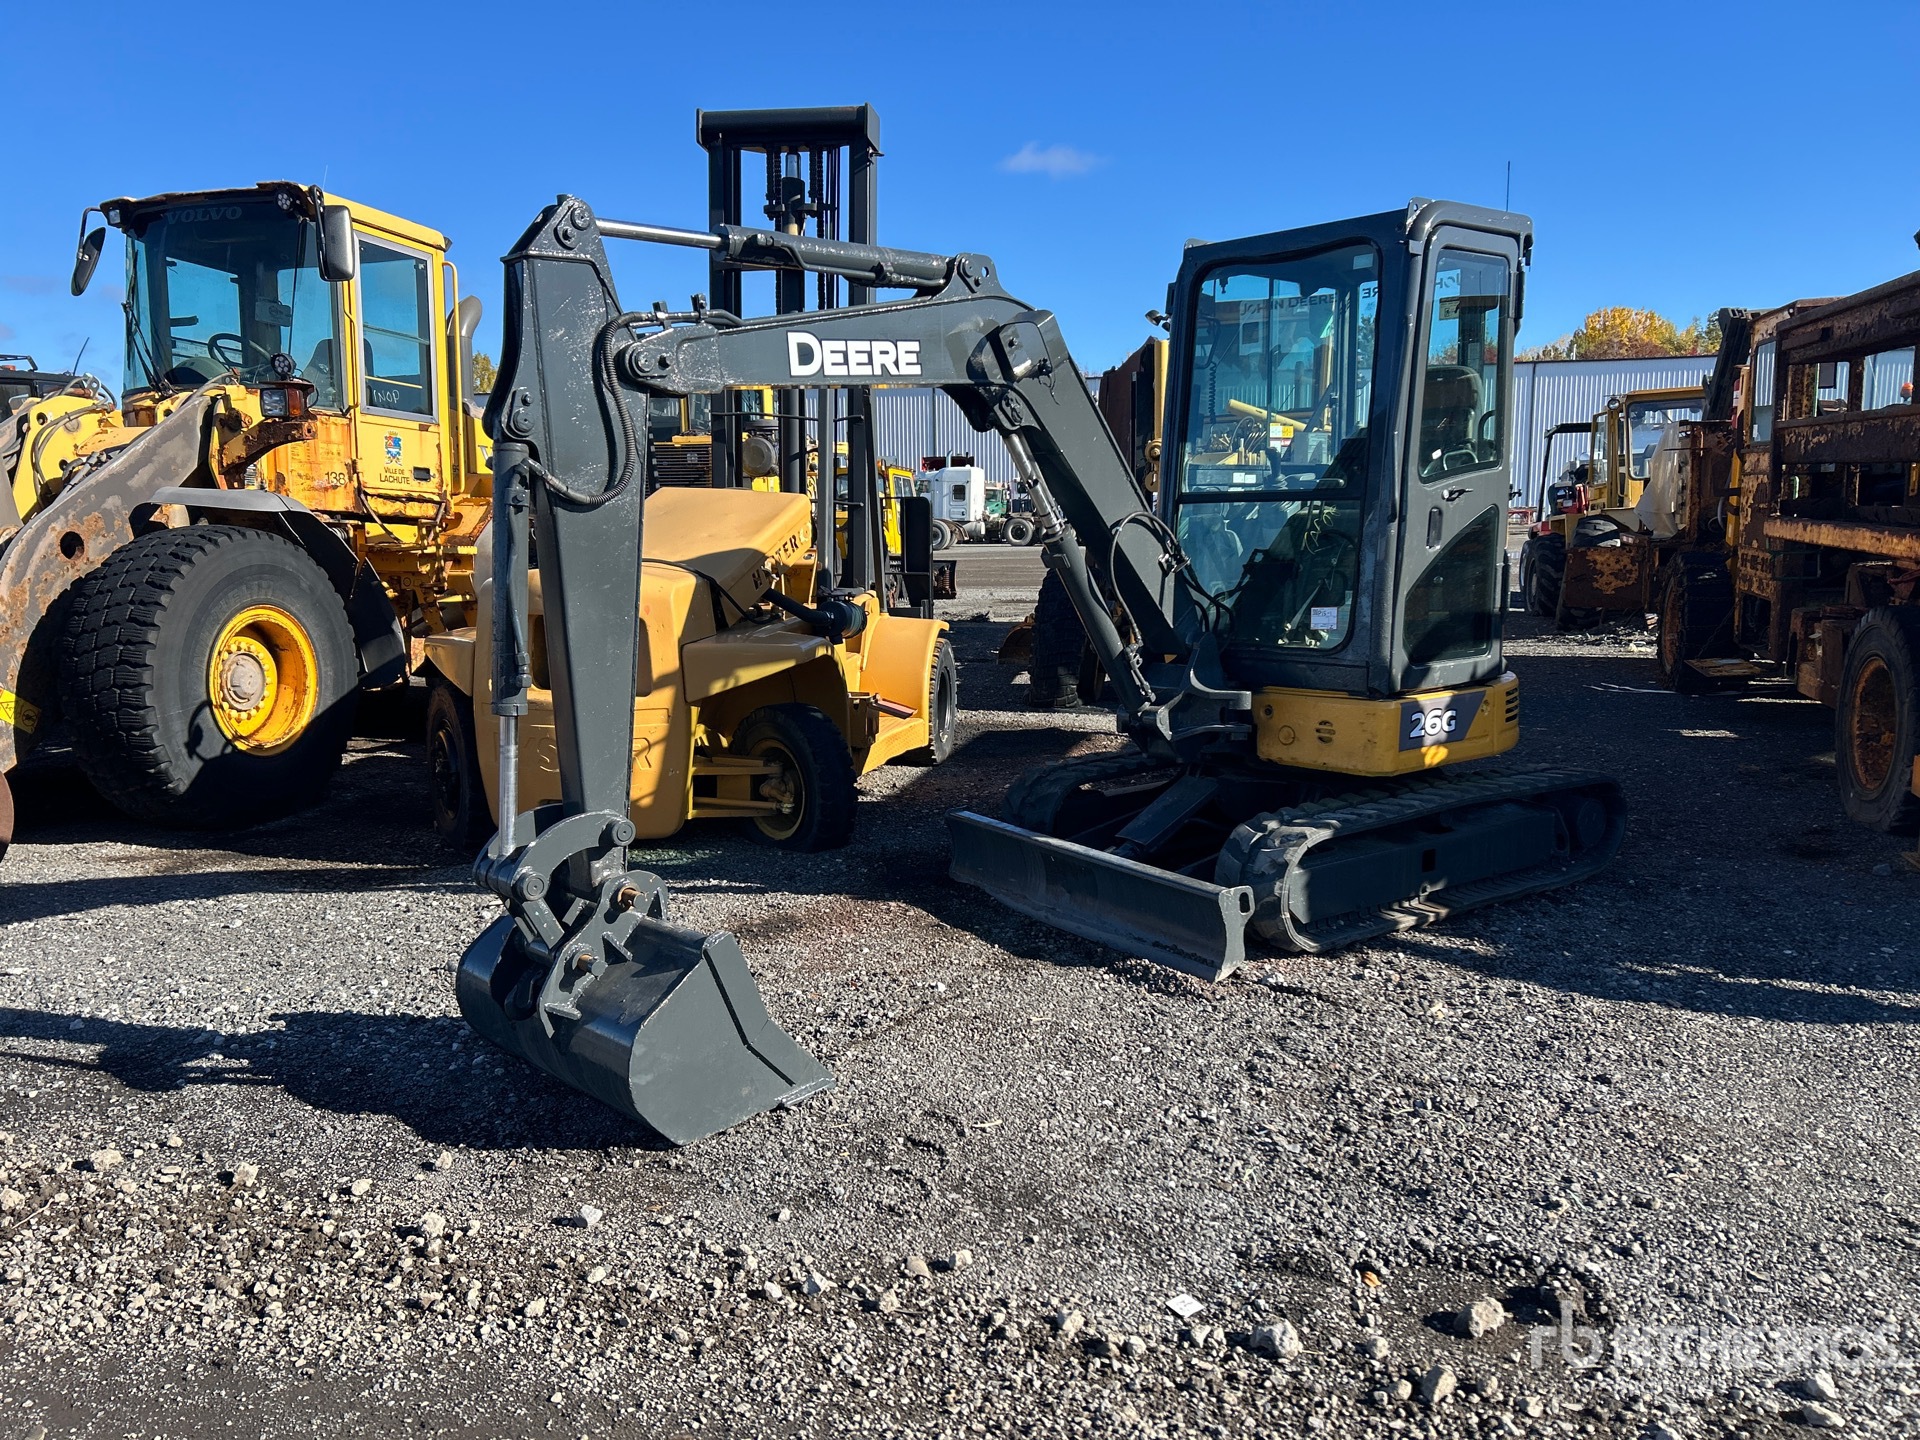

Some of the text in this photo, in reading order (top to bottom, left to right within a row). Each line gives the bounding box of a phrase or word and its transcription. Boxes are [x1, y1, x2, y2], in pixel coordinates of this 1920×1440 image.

[166, 206, 243, 225] VOLVO
[787, 331, 922, 376] DEERE
[324, 471, 346, 486] 138
[379, 472, 411, 485] LACHUTE
[1409, 709, 1457, 738] 26G
